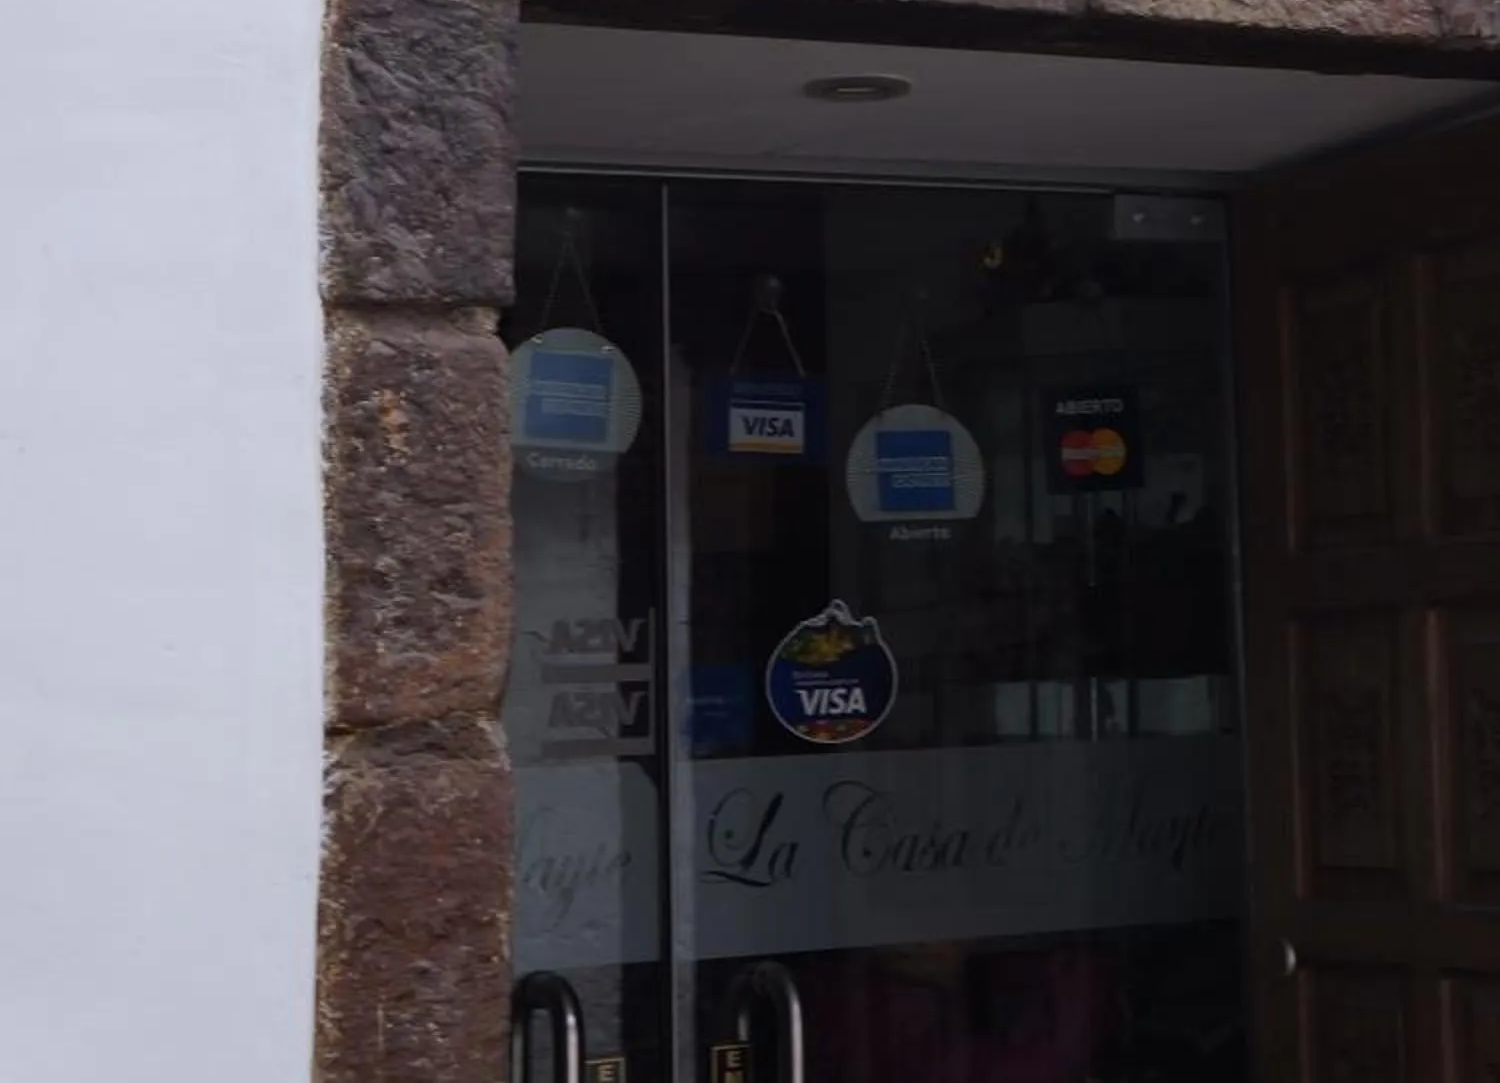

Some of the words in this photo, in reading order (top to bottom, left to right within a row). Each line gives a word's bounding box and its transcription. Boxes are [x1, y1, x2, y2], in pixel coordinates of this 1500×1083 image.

[741, 415, 795, 438] VISA
[794, 686, 868, 716] VISA
[700, 788, 799, 887] La
[823, 780, 970, 877] Casa
